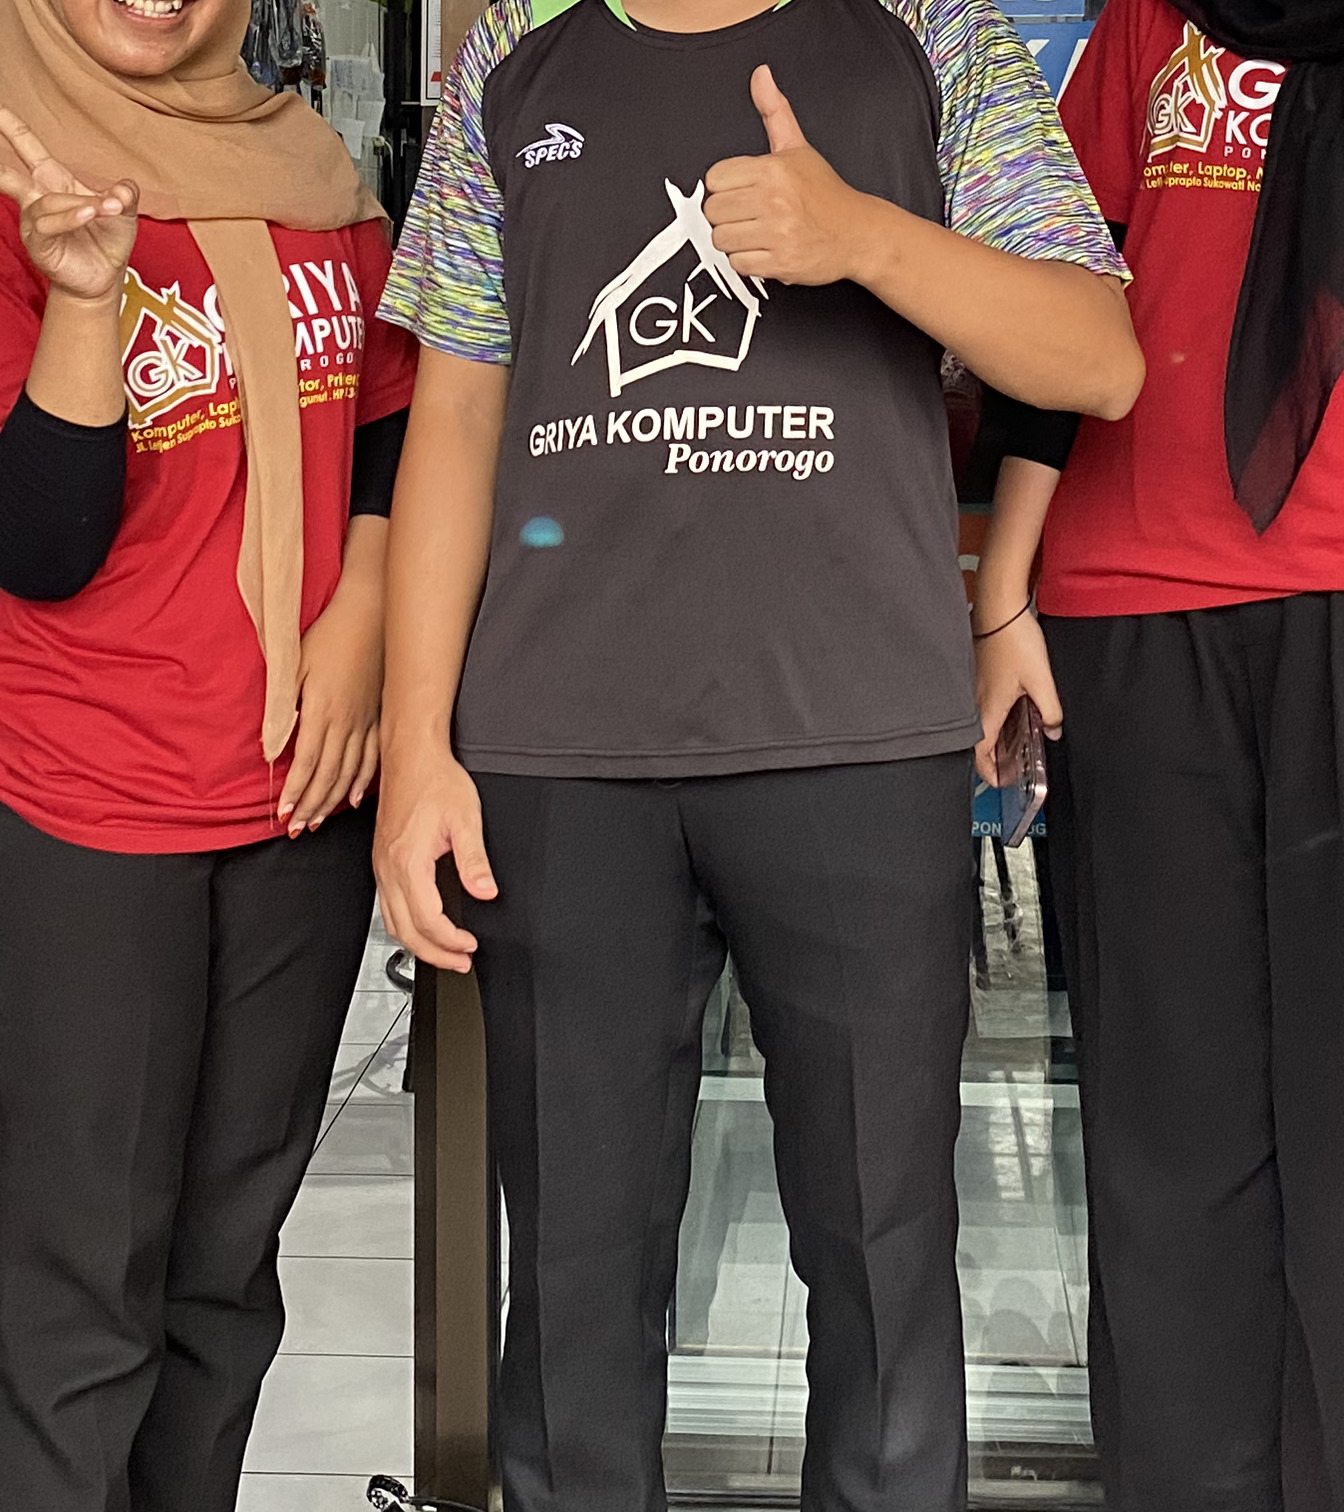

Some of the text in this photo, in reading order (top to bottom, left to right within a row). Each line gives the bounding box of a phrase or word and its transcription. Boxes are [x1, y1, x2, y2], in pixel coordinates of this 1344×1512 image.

[1153, 80, 1196, 135] GK
[1198, 162, 1251, 180] Laptop,
[630, 283, 717, 346] GK
[127, 335, 204, 397] GK
[131, 409, 205, 443] Komputer,
[530, 406, 834, 457] GRIYA KOMPUTER
[665, 443, 835, 480] Ponorogo
